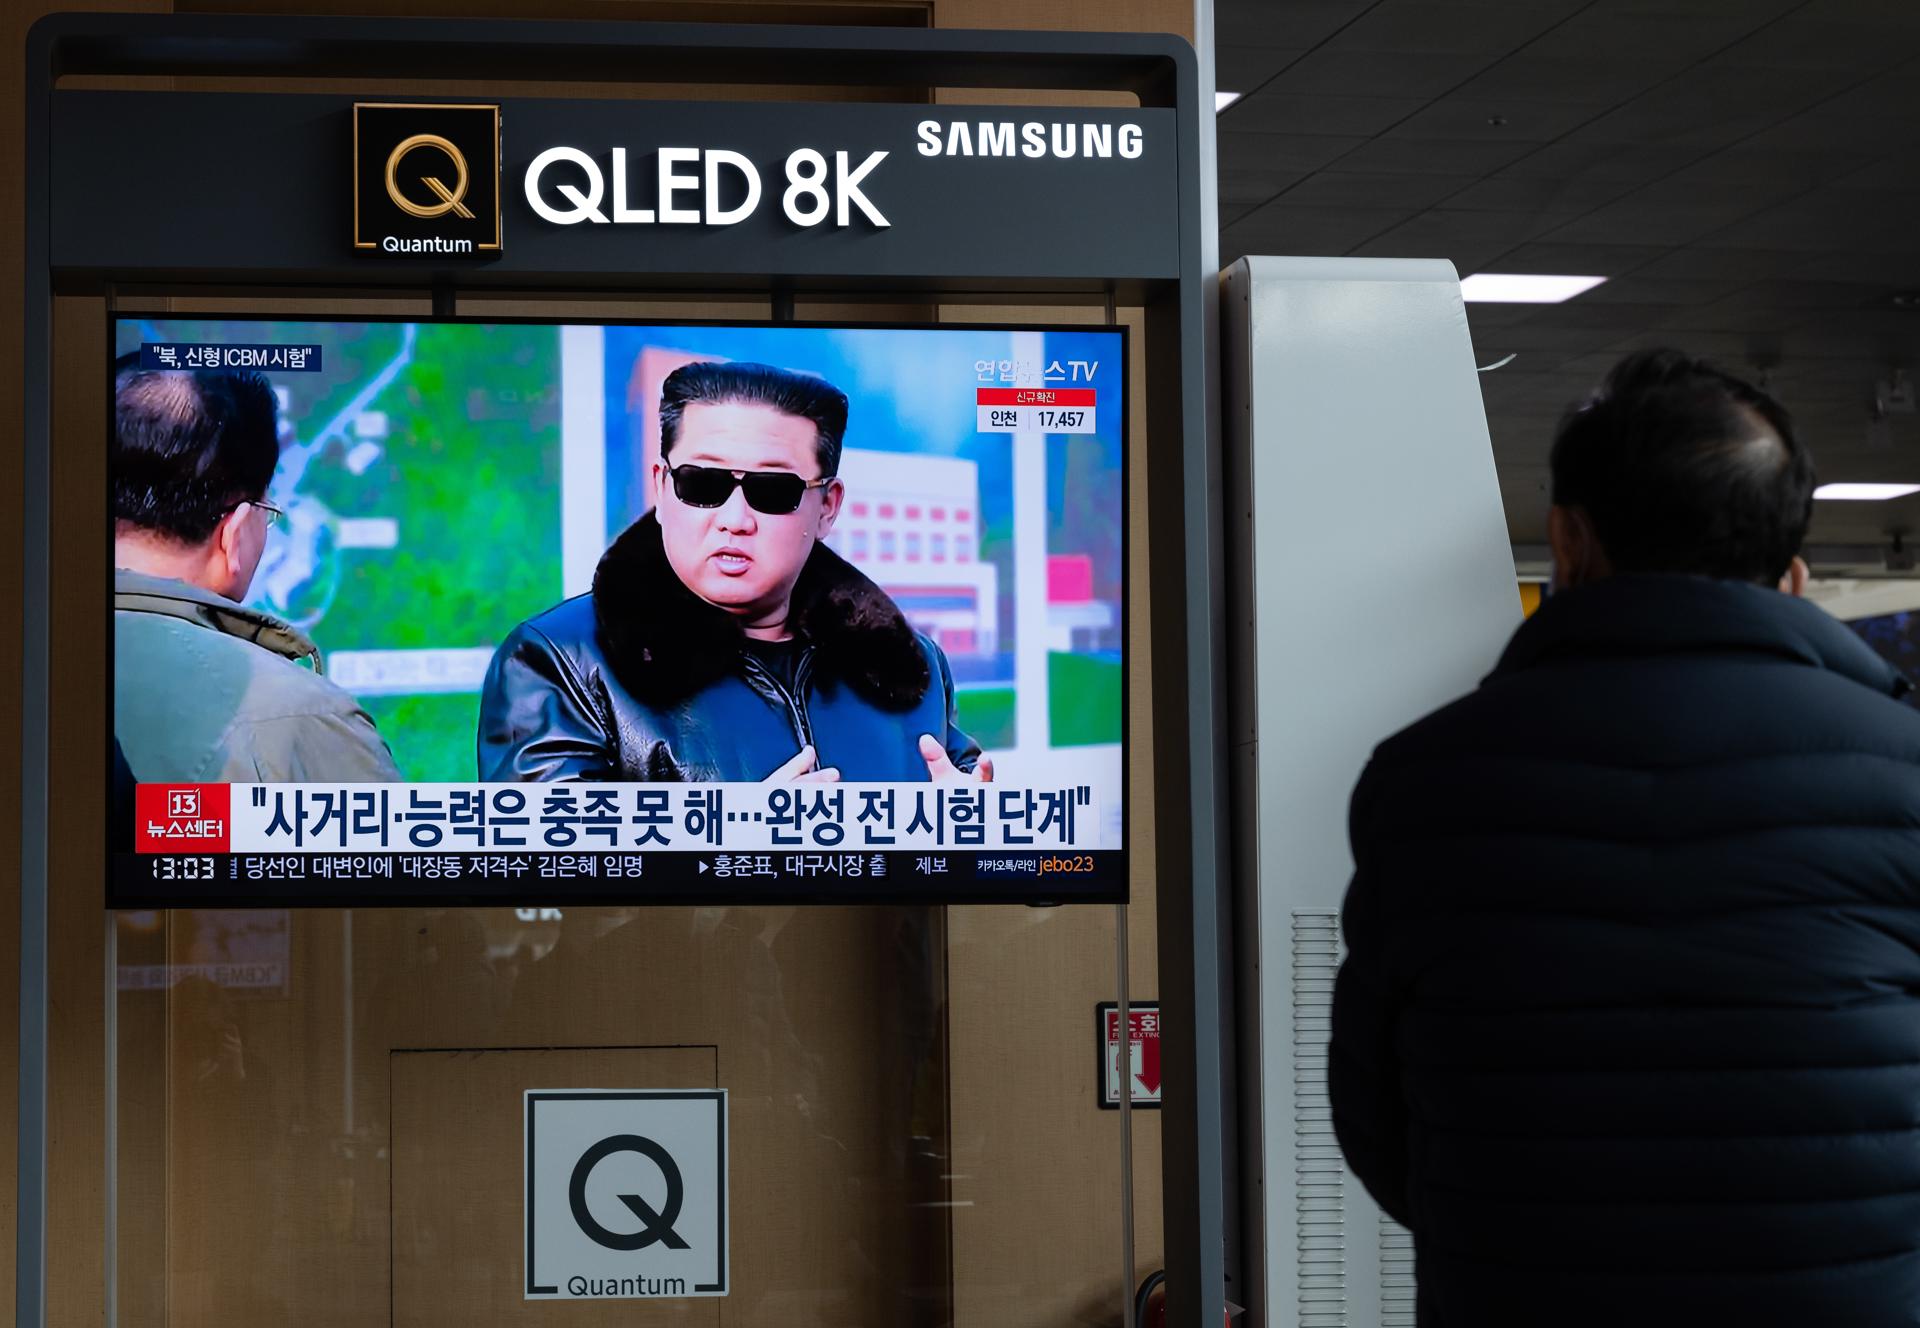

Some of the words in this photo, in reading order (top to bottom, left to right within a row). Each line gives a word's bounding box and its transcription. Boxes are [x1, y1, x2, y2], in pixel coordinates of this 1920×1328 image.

[917, 120, 1143, 159] SAMSUNG
[385, 134, 476, 218] Q
[524, 146, 761, 225] QLED
[782, 148, 891, 227] 8K
[383, 236, 472, 252] Quantum
[153, 346, 181, 368] "북,
[185, 347, 220, 368] 신형
[224, 348, 267, 366] ICBM
[270, 348, 312, 368] 시험"
[974, 360, 1099, 382] 연합스TV
[1016, 391, 1056, 403] 신규확진
[991, 410, 1017, 427] 인천
[1038, 411, 1084, 428] 17,457
[172, 794, 197, 814] 13
[539, 788, 621, 847] 충족
[632, 788, 674, 846] 못
[857, 788, 895, 845] 전
[906, 788, 985, 845] 시험
[999, 785, 1091, 845] 단계"
[146, 820, 223, 838] 뉴스센터
[153, 857, 214, 879] 13:03
[245, 856, 305, 879] 당선인
[313, 855, 393, 878] 대변인에
[399, 855, 463, 878] '대장동
[468, 855, 532, 878] 저격수'
[538, 855, 597, 878] 김은혜
[603, 855, 643, 878] 임명
[713, 855, 777, 879] 홍준표,
[786, 855, 864, 876] 대구시장
[915, 856, 949, 875] 제보
[977, 859, 1036, 872] 카카오톡/라인
[1037, 856, 1094, 876] jebo23
[568, 1134, 692, 1251] Q
[567, 1274, 686, 1296] Quantum
